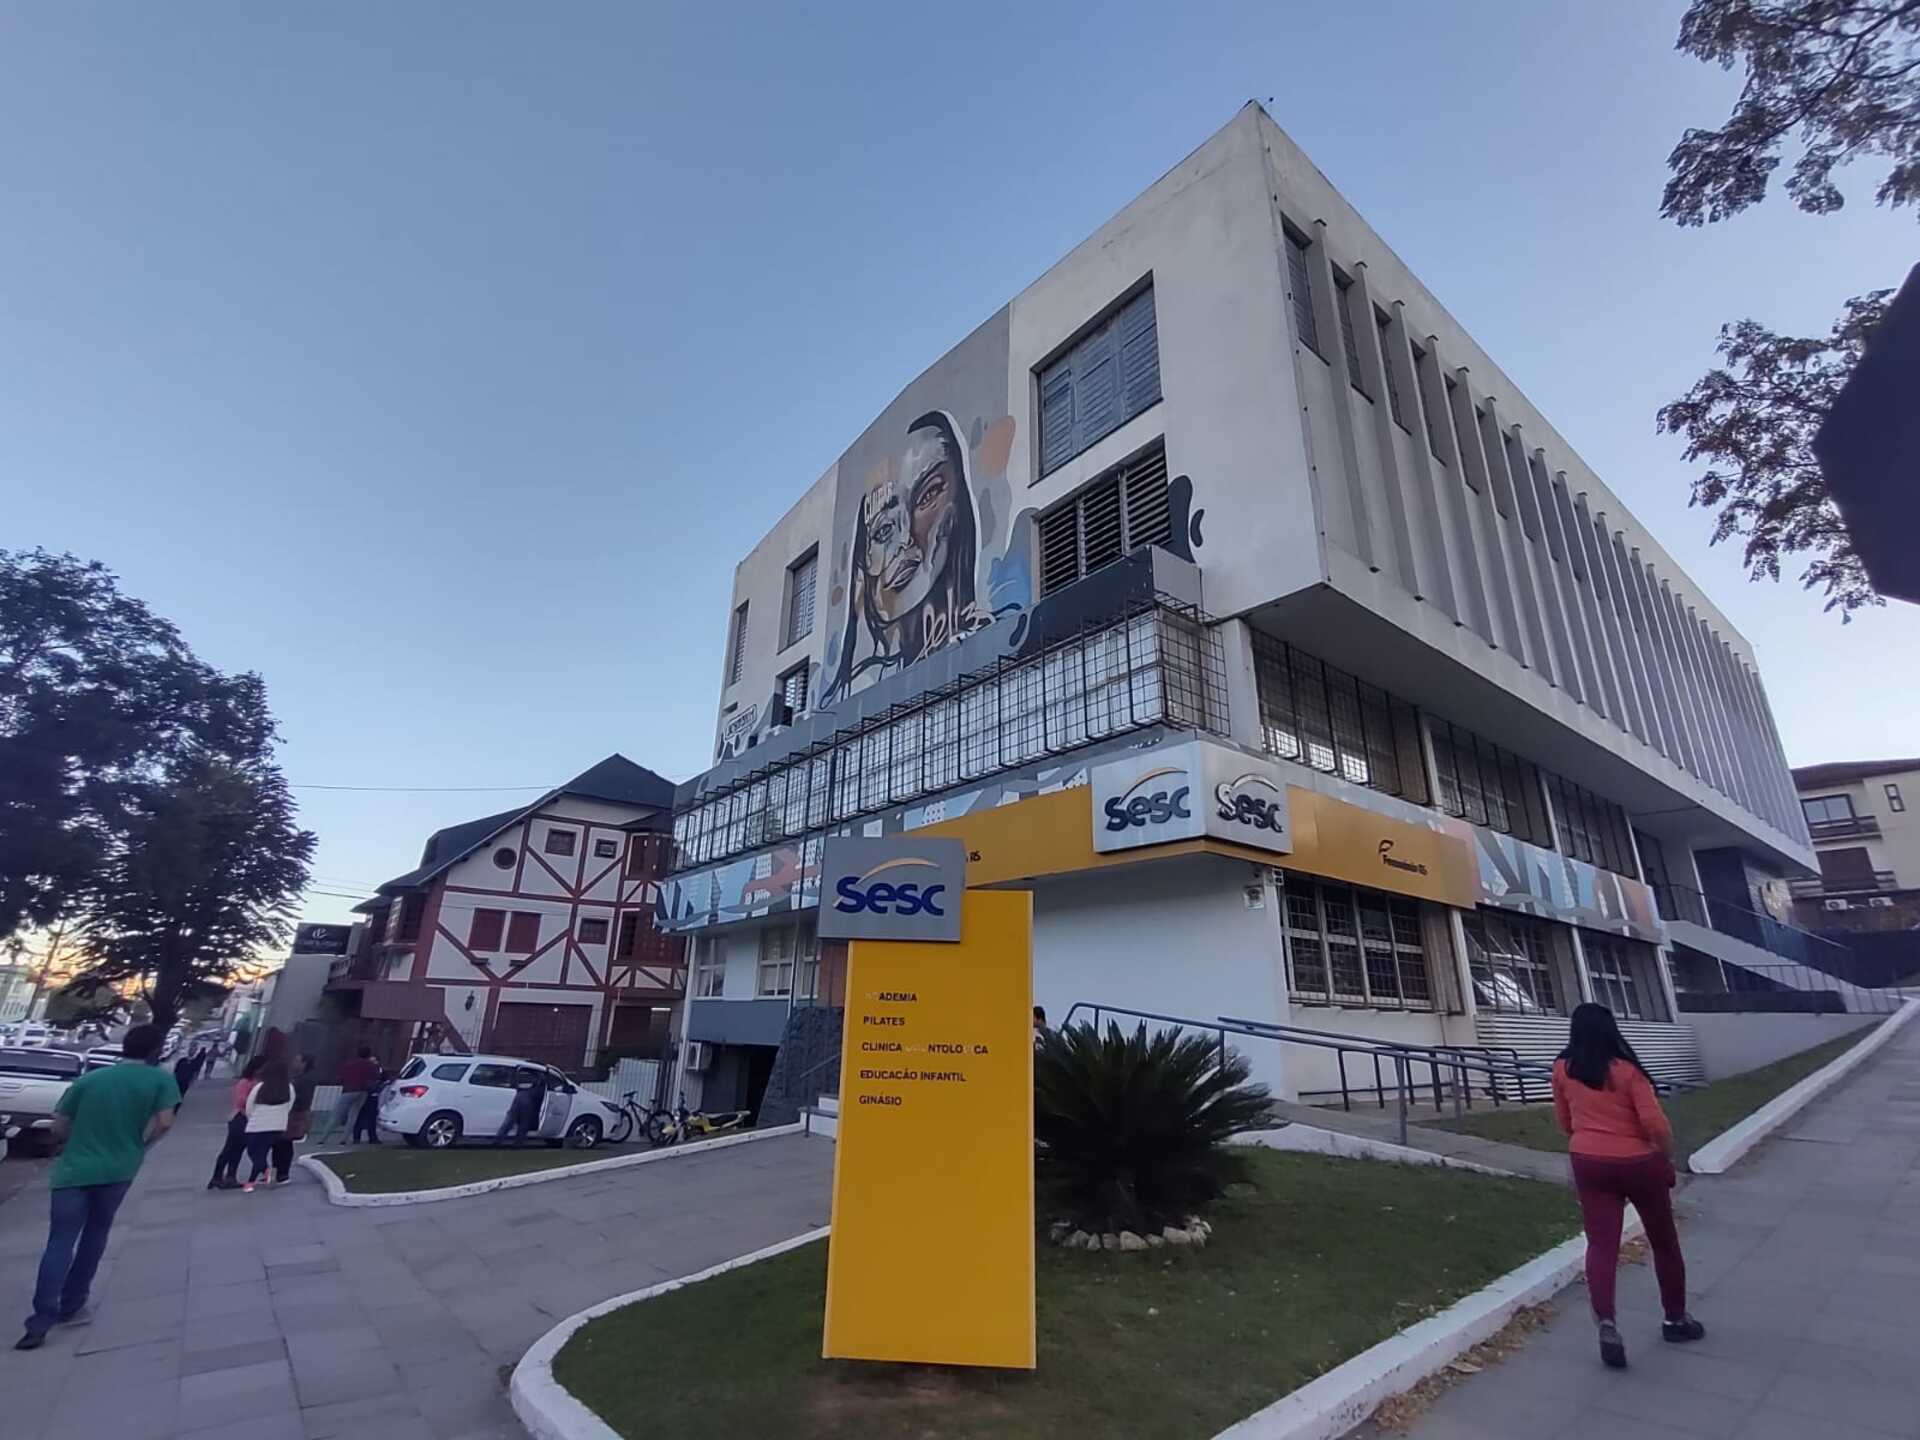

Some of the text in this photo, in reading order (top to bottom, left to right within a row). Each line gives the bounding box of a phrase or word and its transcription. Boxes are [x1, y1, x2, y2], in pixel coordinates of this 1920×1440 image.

[1104, 786, 1191, 832] Sesc
[1215, 783, 1284, 833] Sesc
[834, 876, 946, 917] Sesc
[864, 991, 918, 1003] ADEMIA
[863, 1015, 906, 1026] PILATES
[920, 1071, 967, 1083] INFANTIL
[858, 1091, 902, 1106] GINÁSIO
